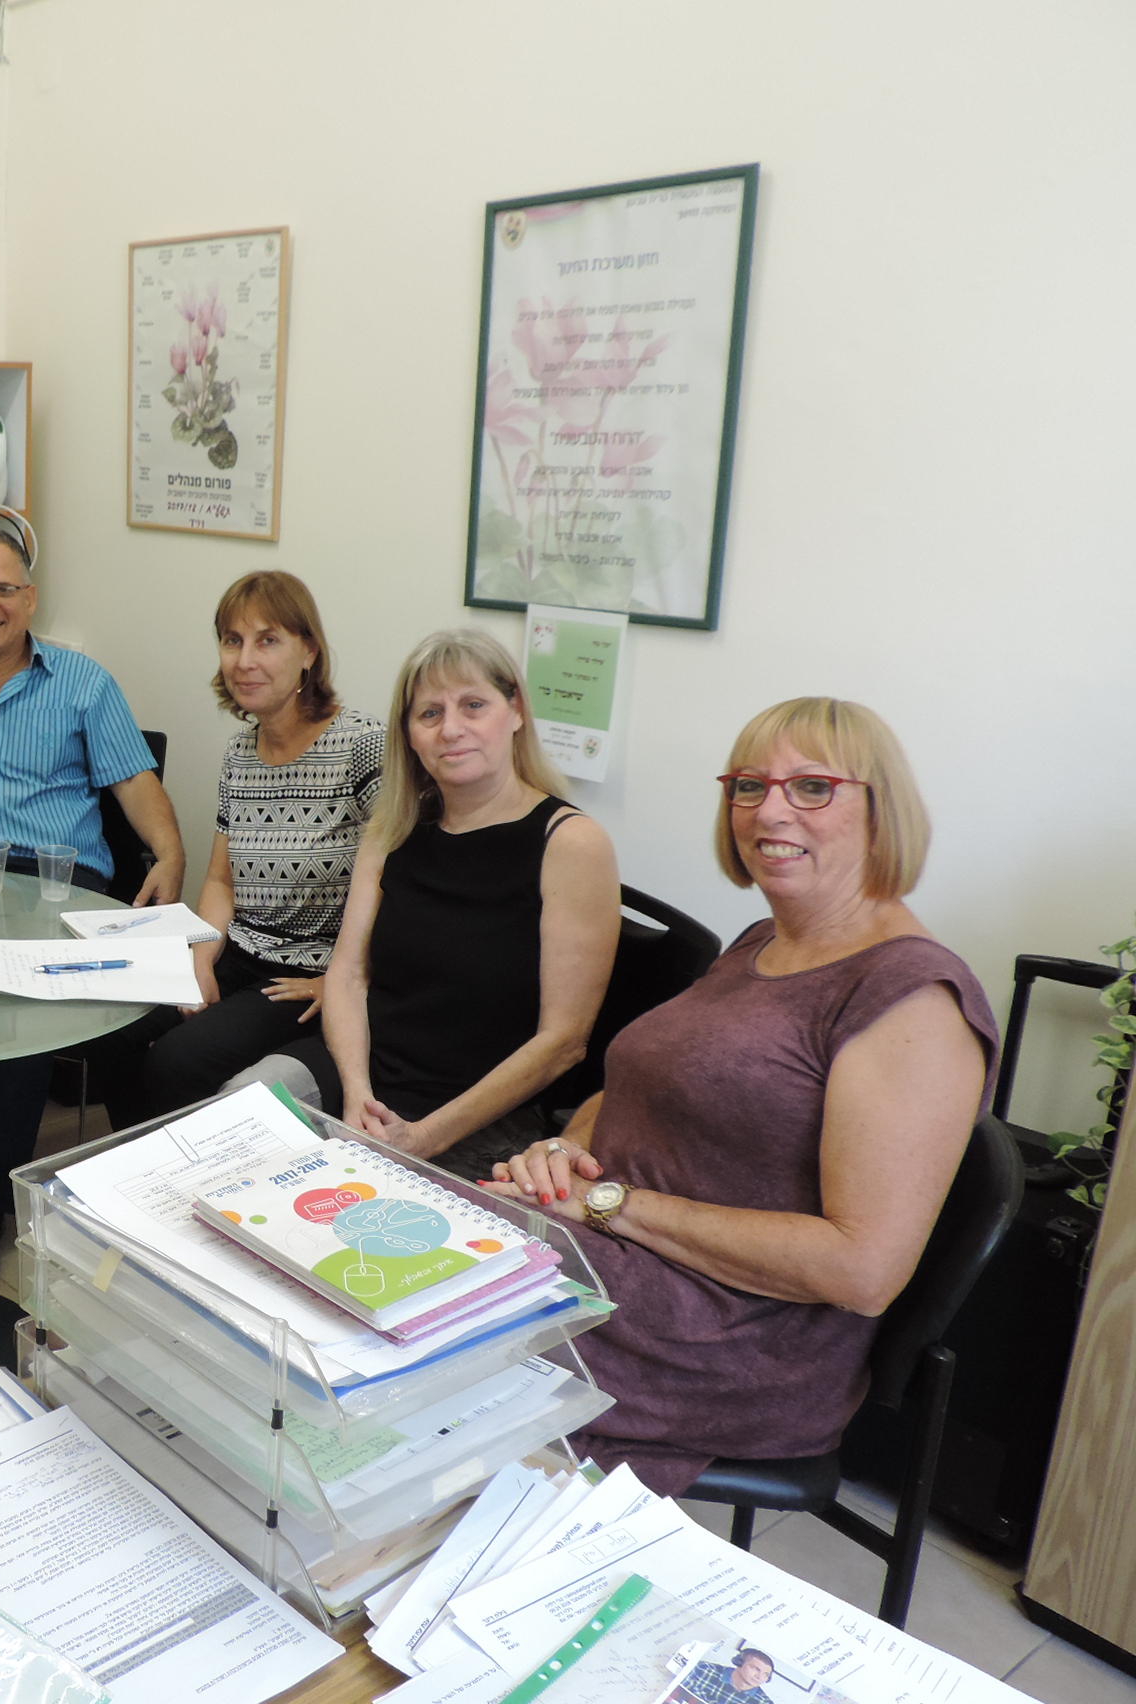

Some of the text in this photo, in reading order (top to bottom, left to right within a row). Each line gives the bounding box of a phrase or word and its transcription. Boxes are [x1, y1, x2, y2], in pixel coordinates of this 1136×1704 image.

[557, 251, 659, 277] חזון מערכת החינוך
[167, 471, 232, 490] פורום מנהלים
[268, 1158, 329, 1185] 2017-2018
